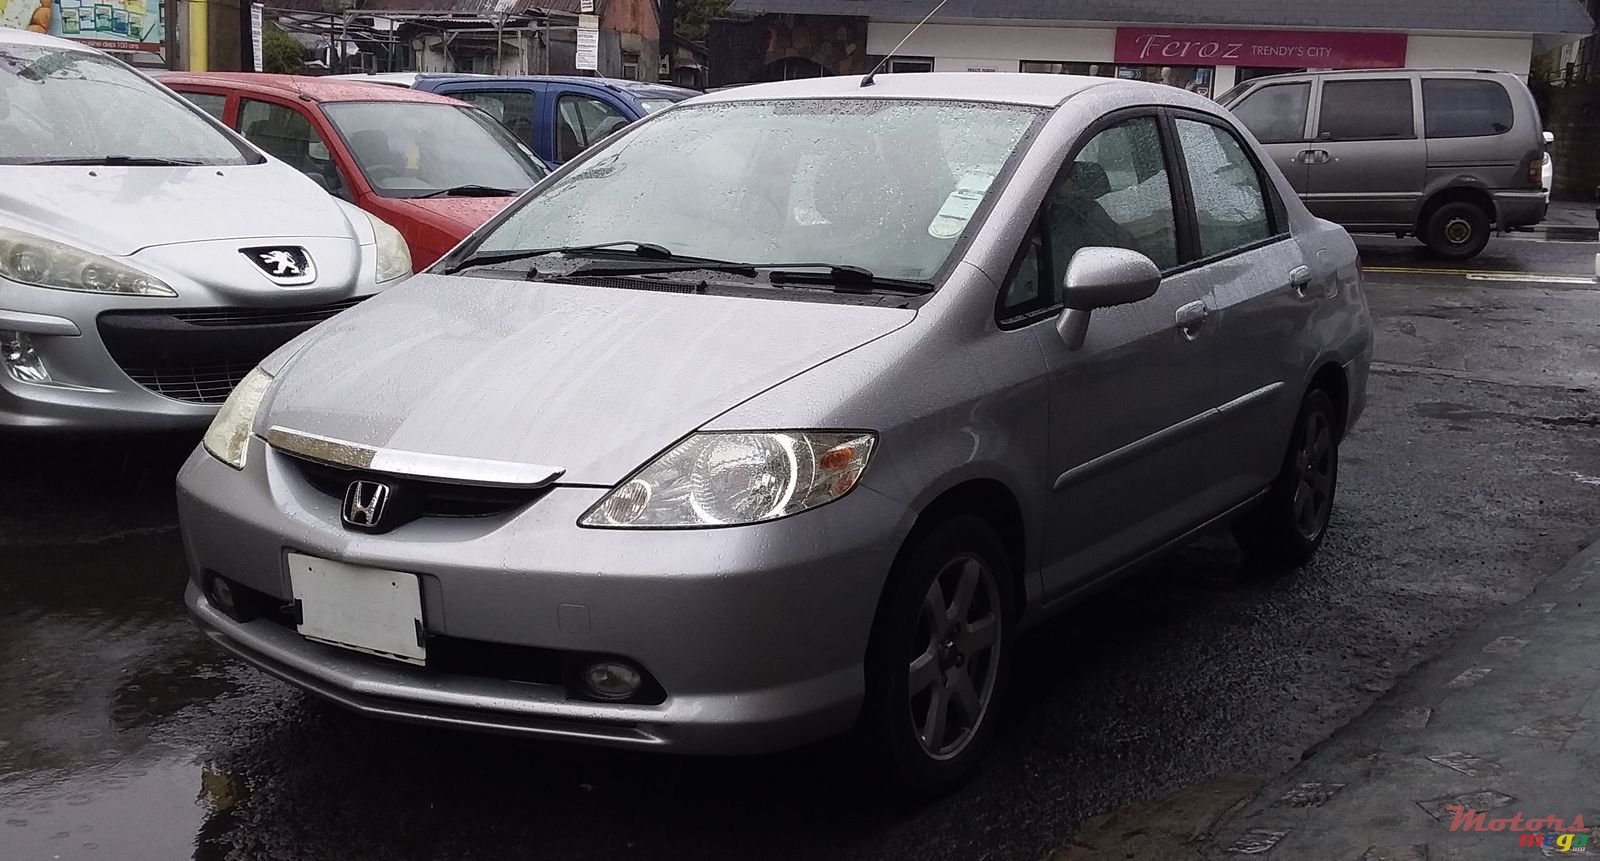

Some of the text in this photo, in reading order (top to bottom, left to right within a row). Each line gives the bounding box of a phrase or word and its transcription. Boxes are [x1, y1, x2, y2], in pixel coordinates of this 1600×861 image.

[1135, 34, 1333, 59] Feroz TRENDY'S CITY
